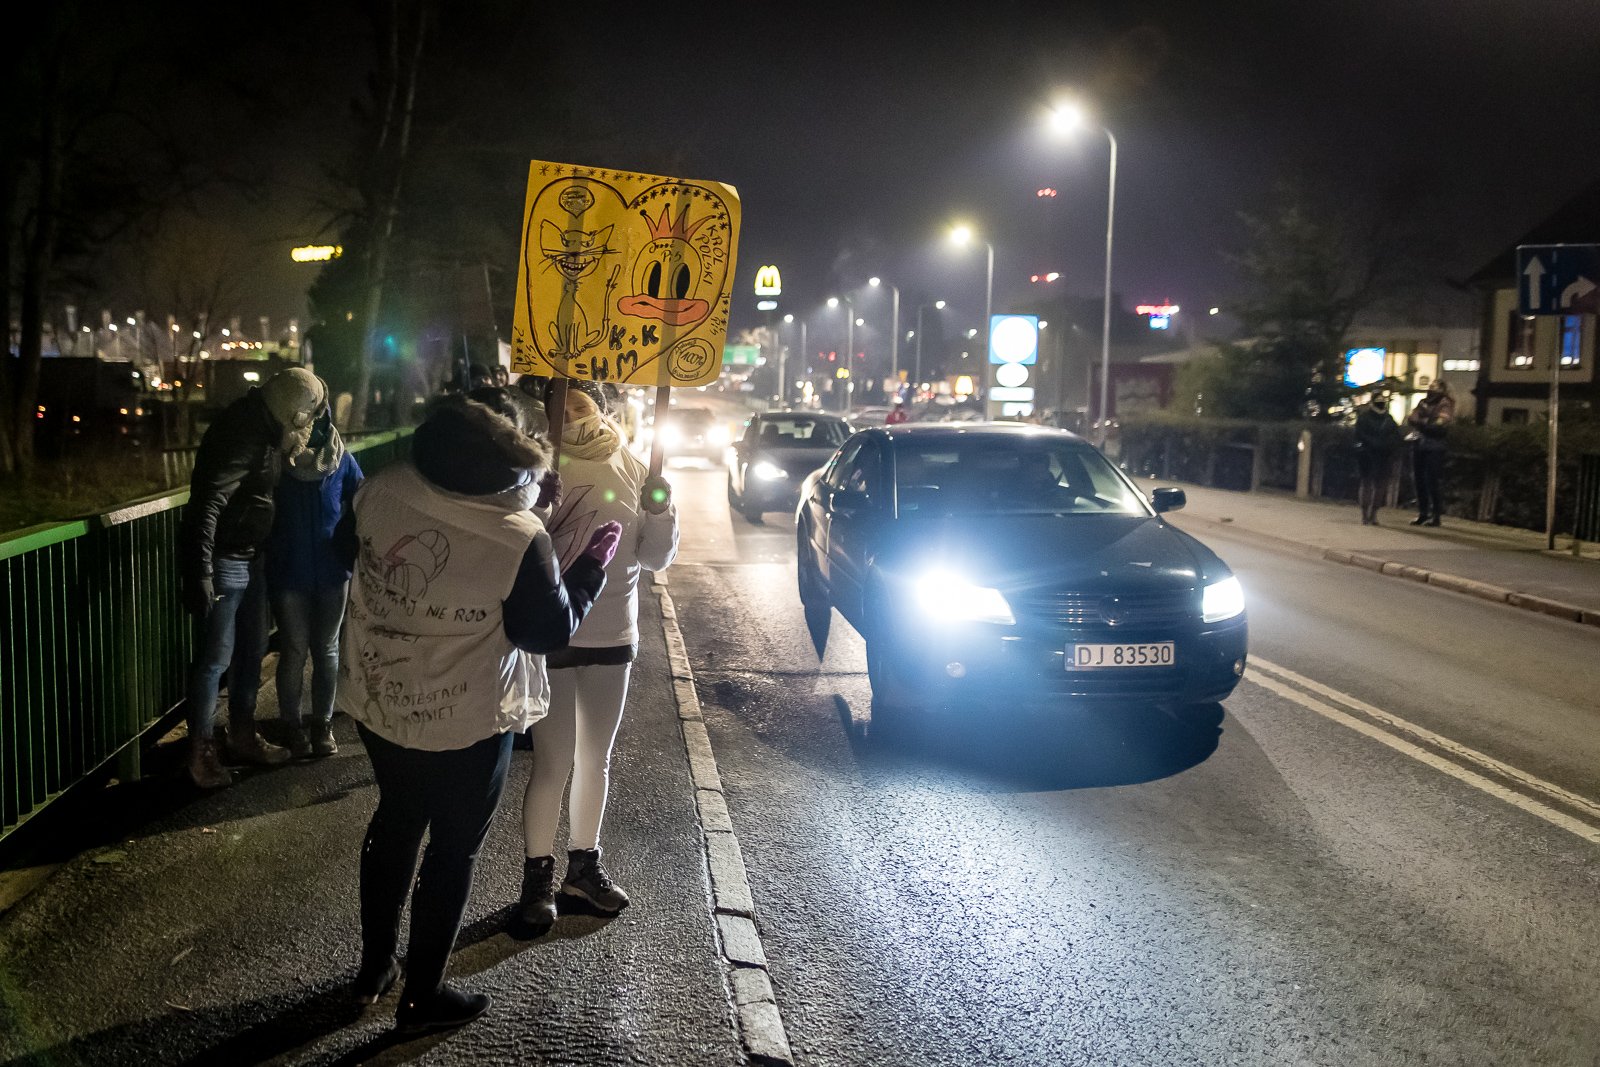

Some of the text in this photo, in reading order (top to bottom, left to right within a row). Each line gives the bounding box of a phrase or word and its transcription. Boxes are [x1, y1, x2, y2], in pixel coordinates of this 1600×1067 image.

[706, 224, 727, 265] KRÓL
[694, 233, 714, 285] POLSKI
[425, 604, 448, 620] NIE
[1078, 645, 1171, 665] DJ 83530
[382, 681, 468, 708] PROTESTACH
[383, 680, 404, 695] PO
